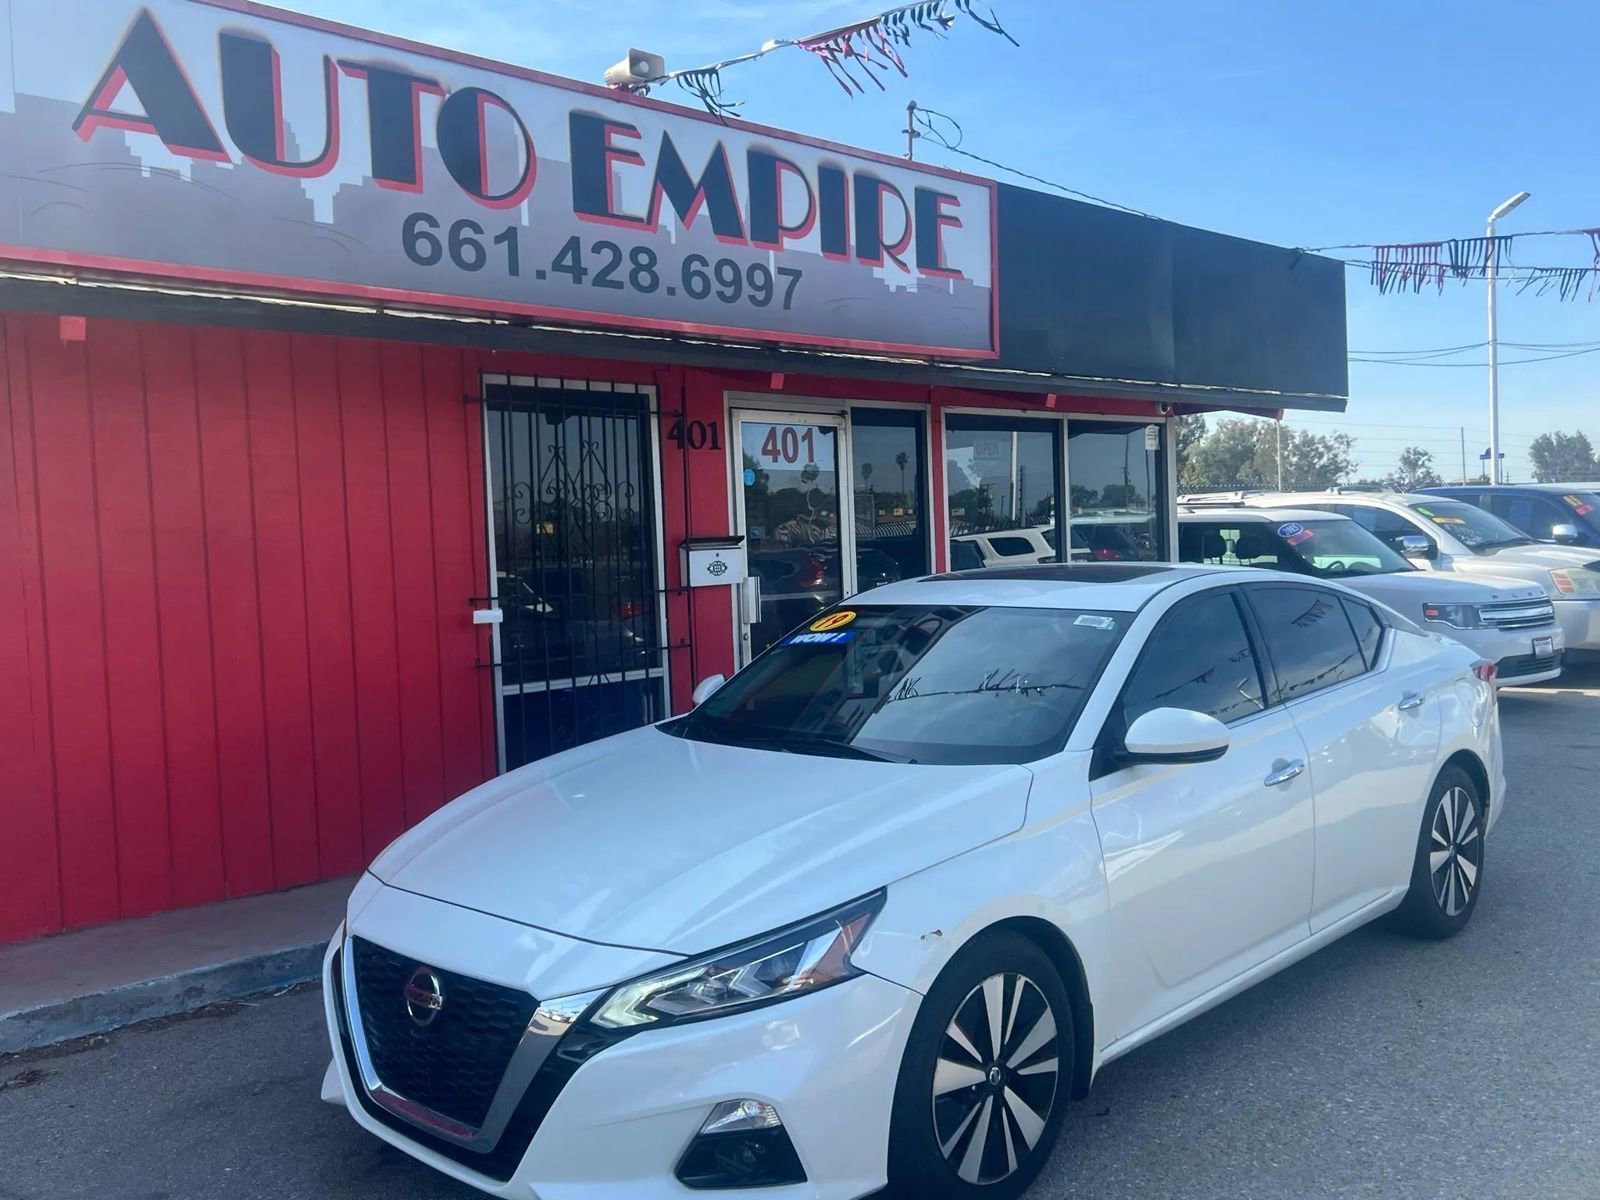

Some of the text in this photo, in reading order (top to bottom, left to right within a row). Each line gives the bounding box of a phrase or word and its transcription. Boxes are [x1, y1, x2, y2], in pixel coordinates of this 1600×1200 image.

[73, 7, 965, 280] AUTO EMPIRE
[402, 211, 803, 311] 661.428.6997
[667, 416, 722, 450] 401
[761, 426, 815, 464] 401
